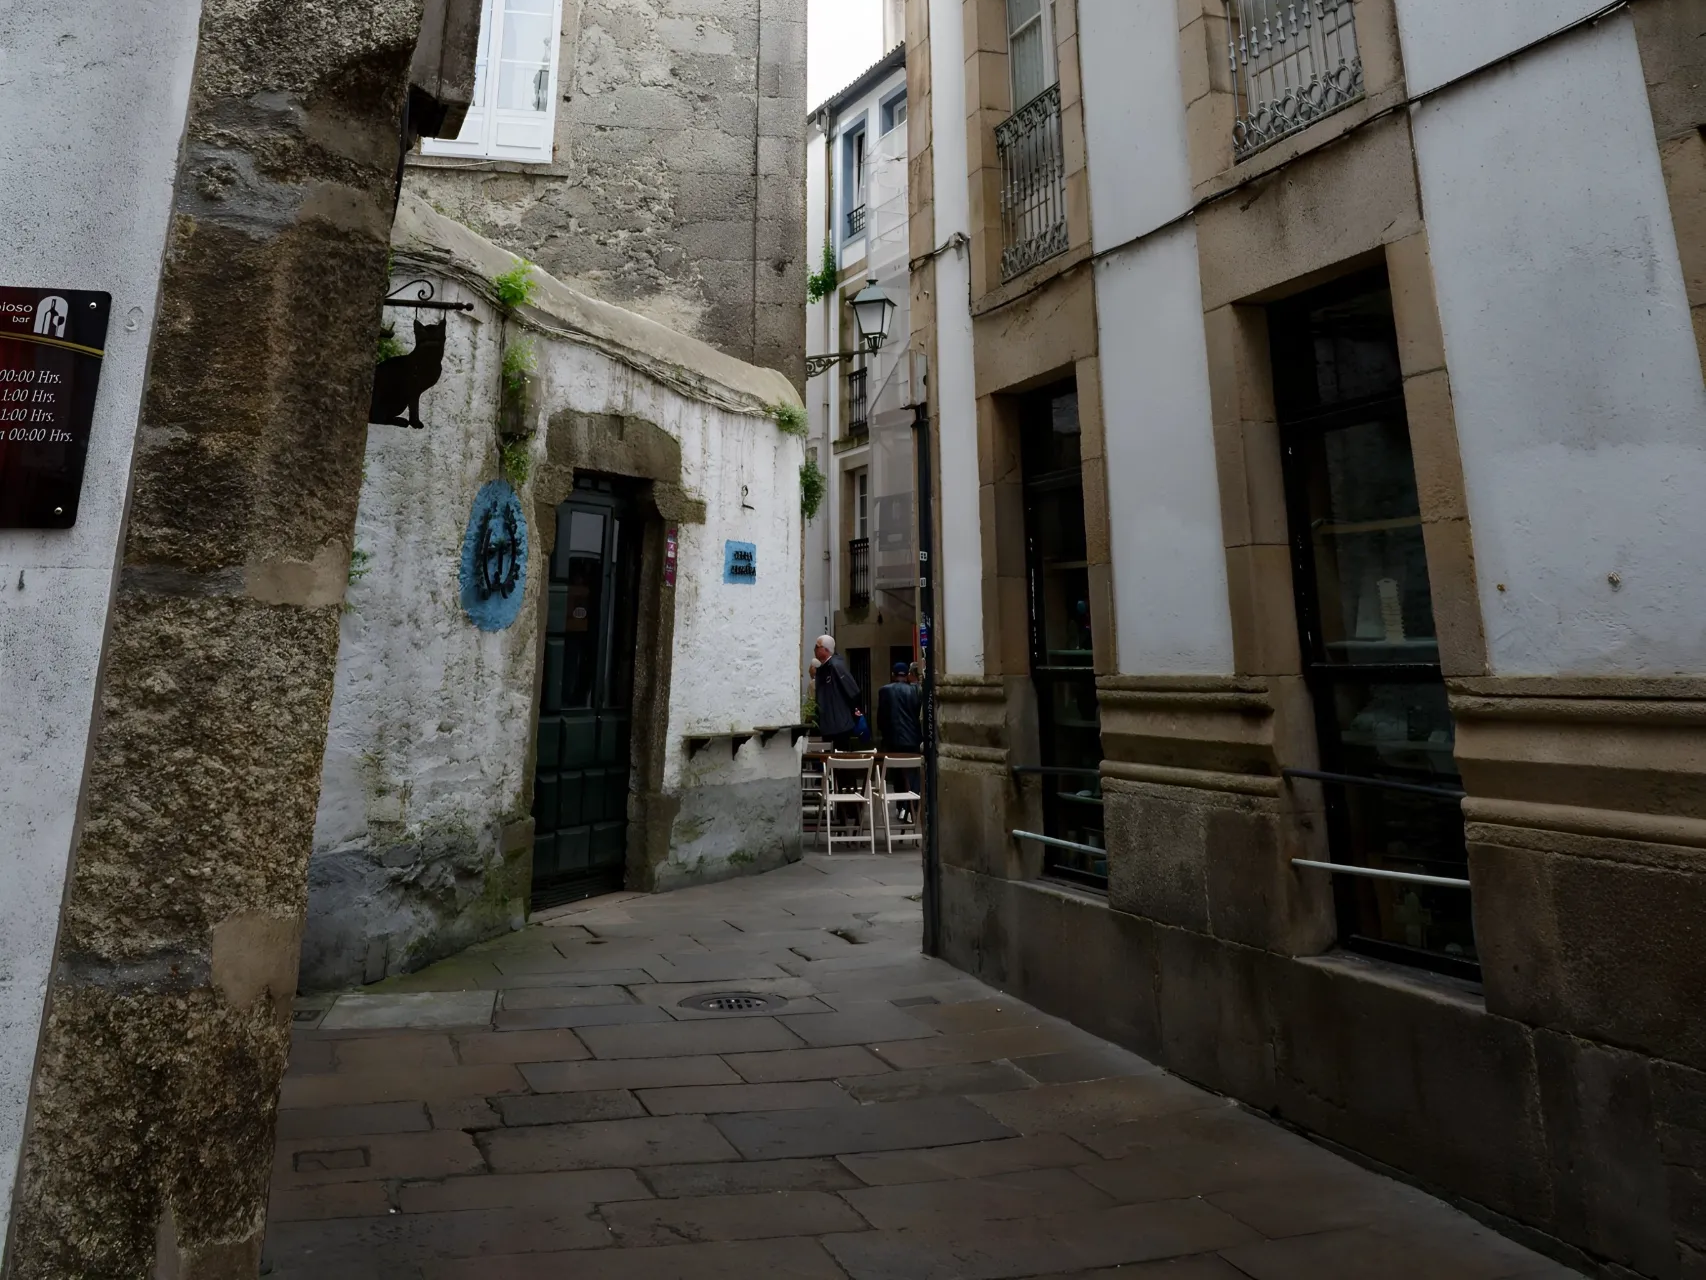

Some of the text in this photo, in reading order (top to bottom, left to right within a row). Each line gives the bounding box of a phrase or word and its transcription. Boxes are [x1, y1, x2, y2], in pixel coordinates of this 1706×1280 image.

[0, 301, 33, 313] ioso
[12, 315, 30, 323] bar
[37, 370, 62, 384] Hrs.
[31, 389, 56, 403] Hrs.
[30, 408, 55, 422] Hrs.
[8, 427, 46, 442] 00:00
[49, 428, 73, 442] Hrs.
